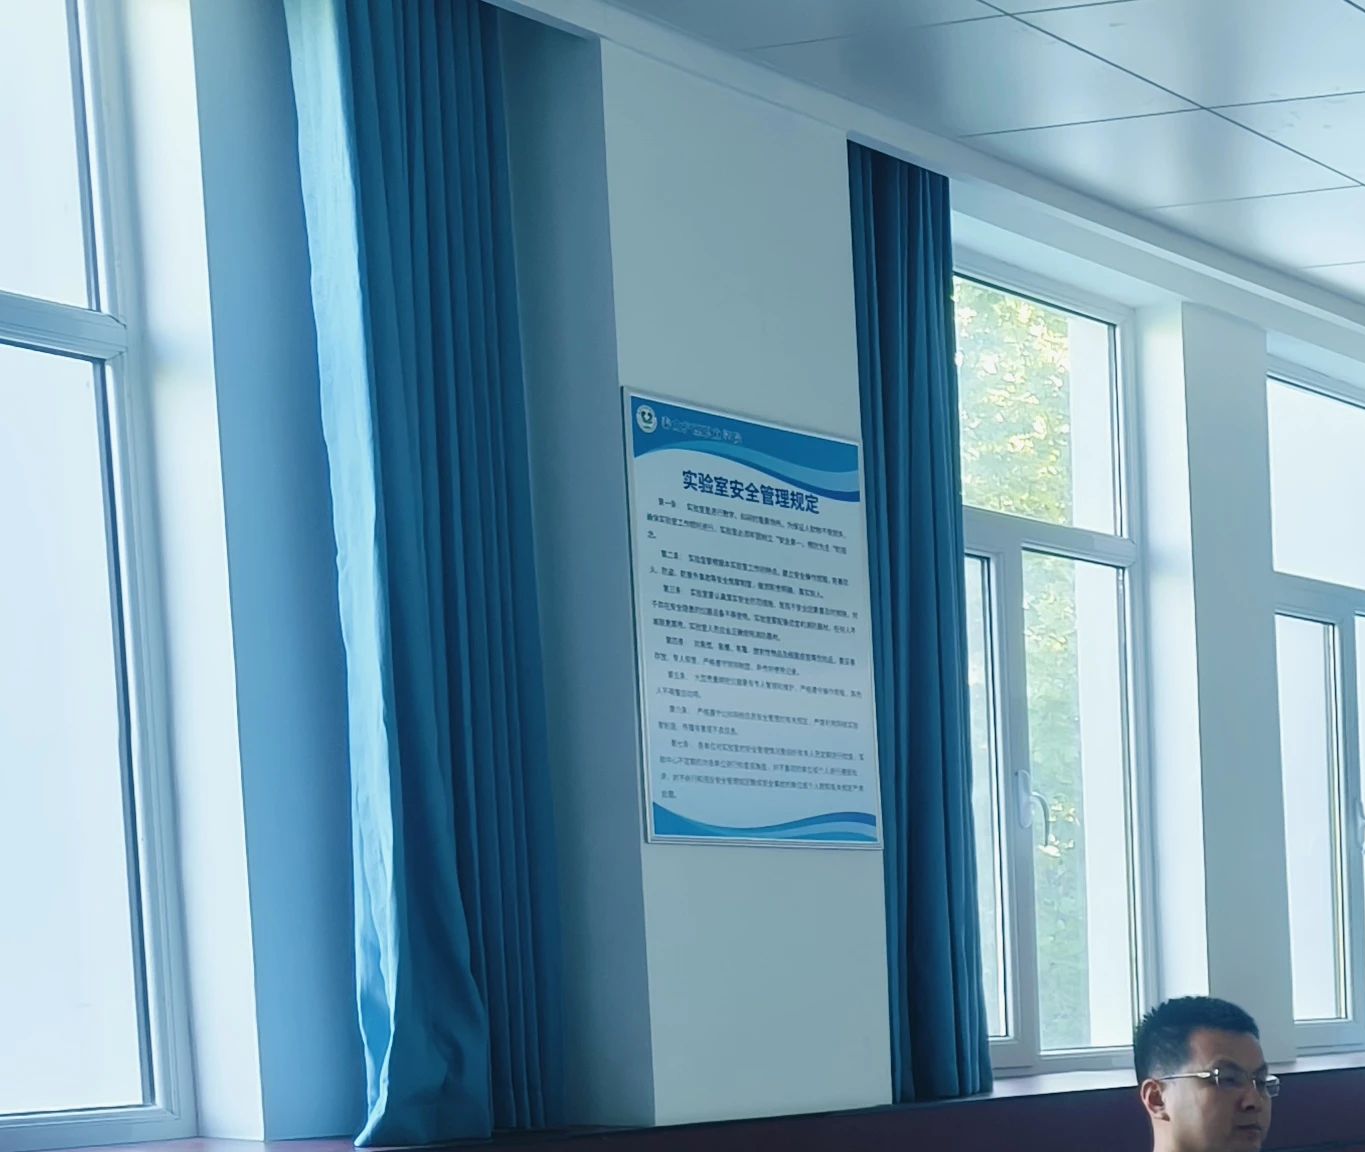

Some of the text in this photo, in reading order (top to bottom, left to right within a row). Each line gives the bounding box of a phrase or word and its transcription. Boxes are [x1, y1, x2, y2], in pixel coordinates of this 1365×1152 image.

[682, 470, 820, 515] 实验室安全管理规定
